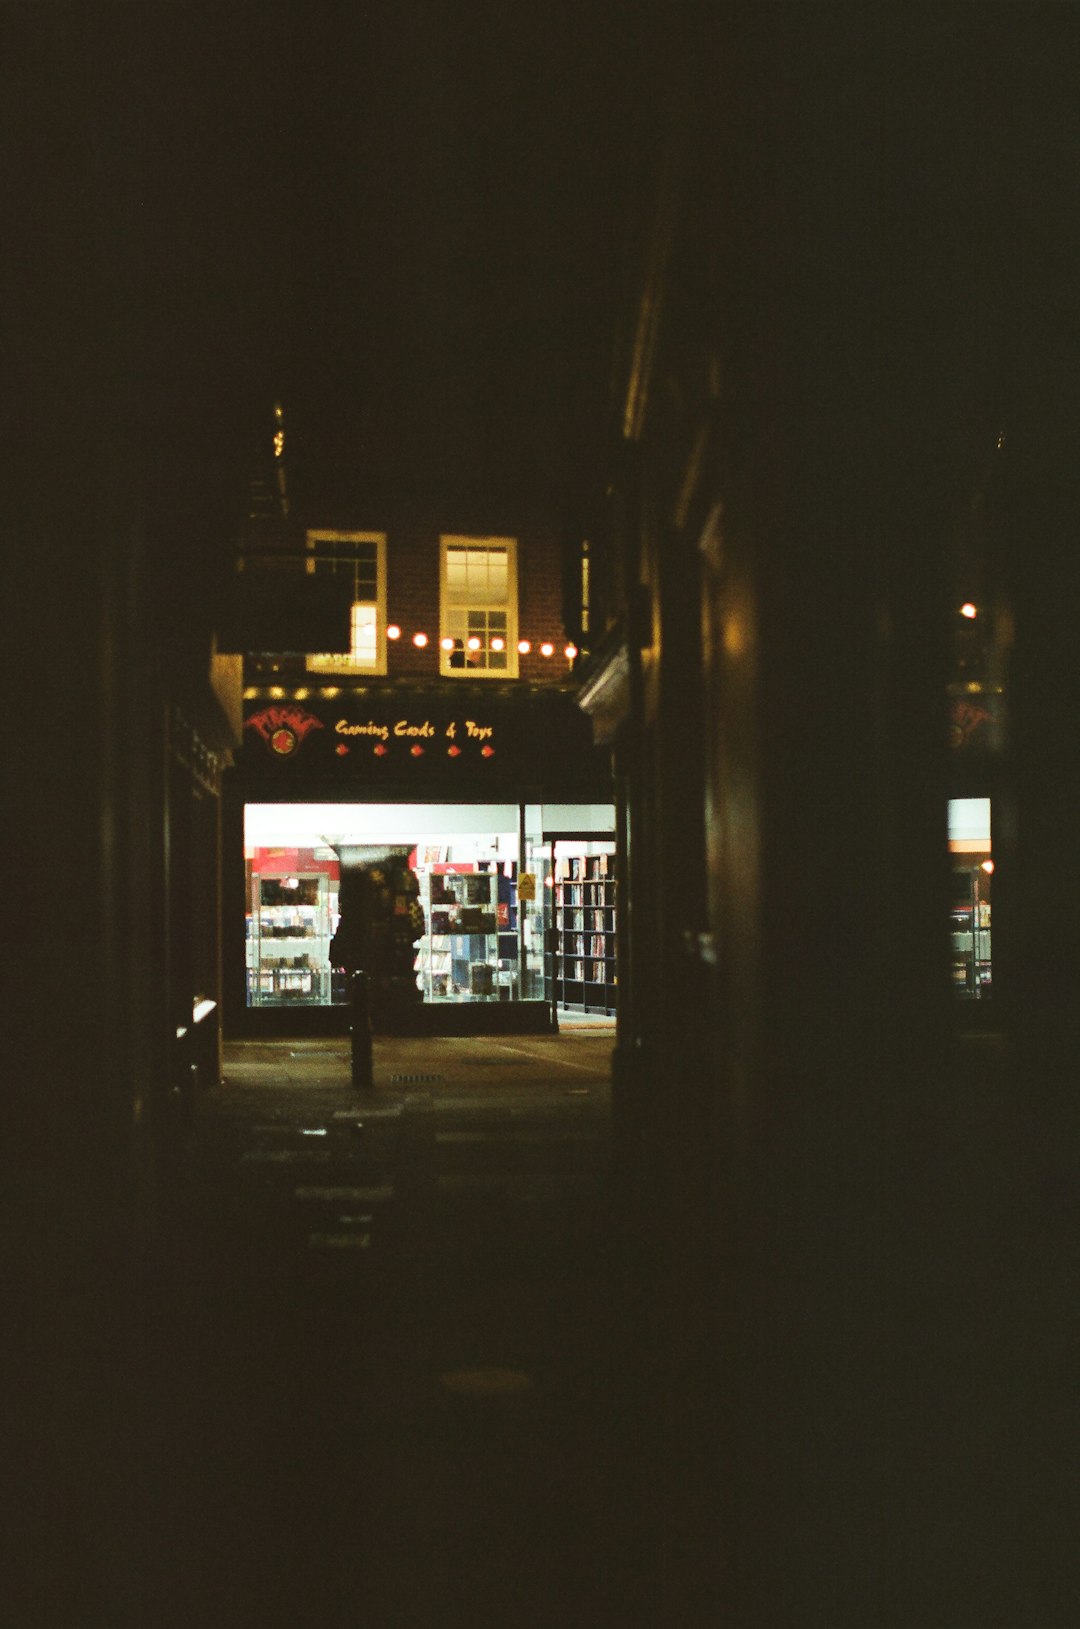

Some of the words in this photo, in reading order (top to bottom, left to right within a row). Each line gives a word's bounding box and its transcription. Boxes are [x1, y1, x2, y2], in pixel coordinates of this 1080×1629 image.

[334, 719, 388, 741] Gaming
[393, 720, 435, 738] Cards
[445, 721, 457, 739] &
[465, 720, 493, 741] Toys
